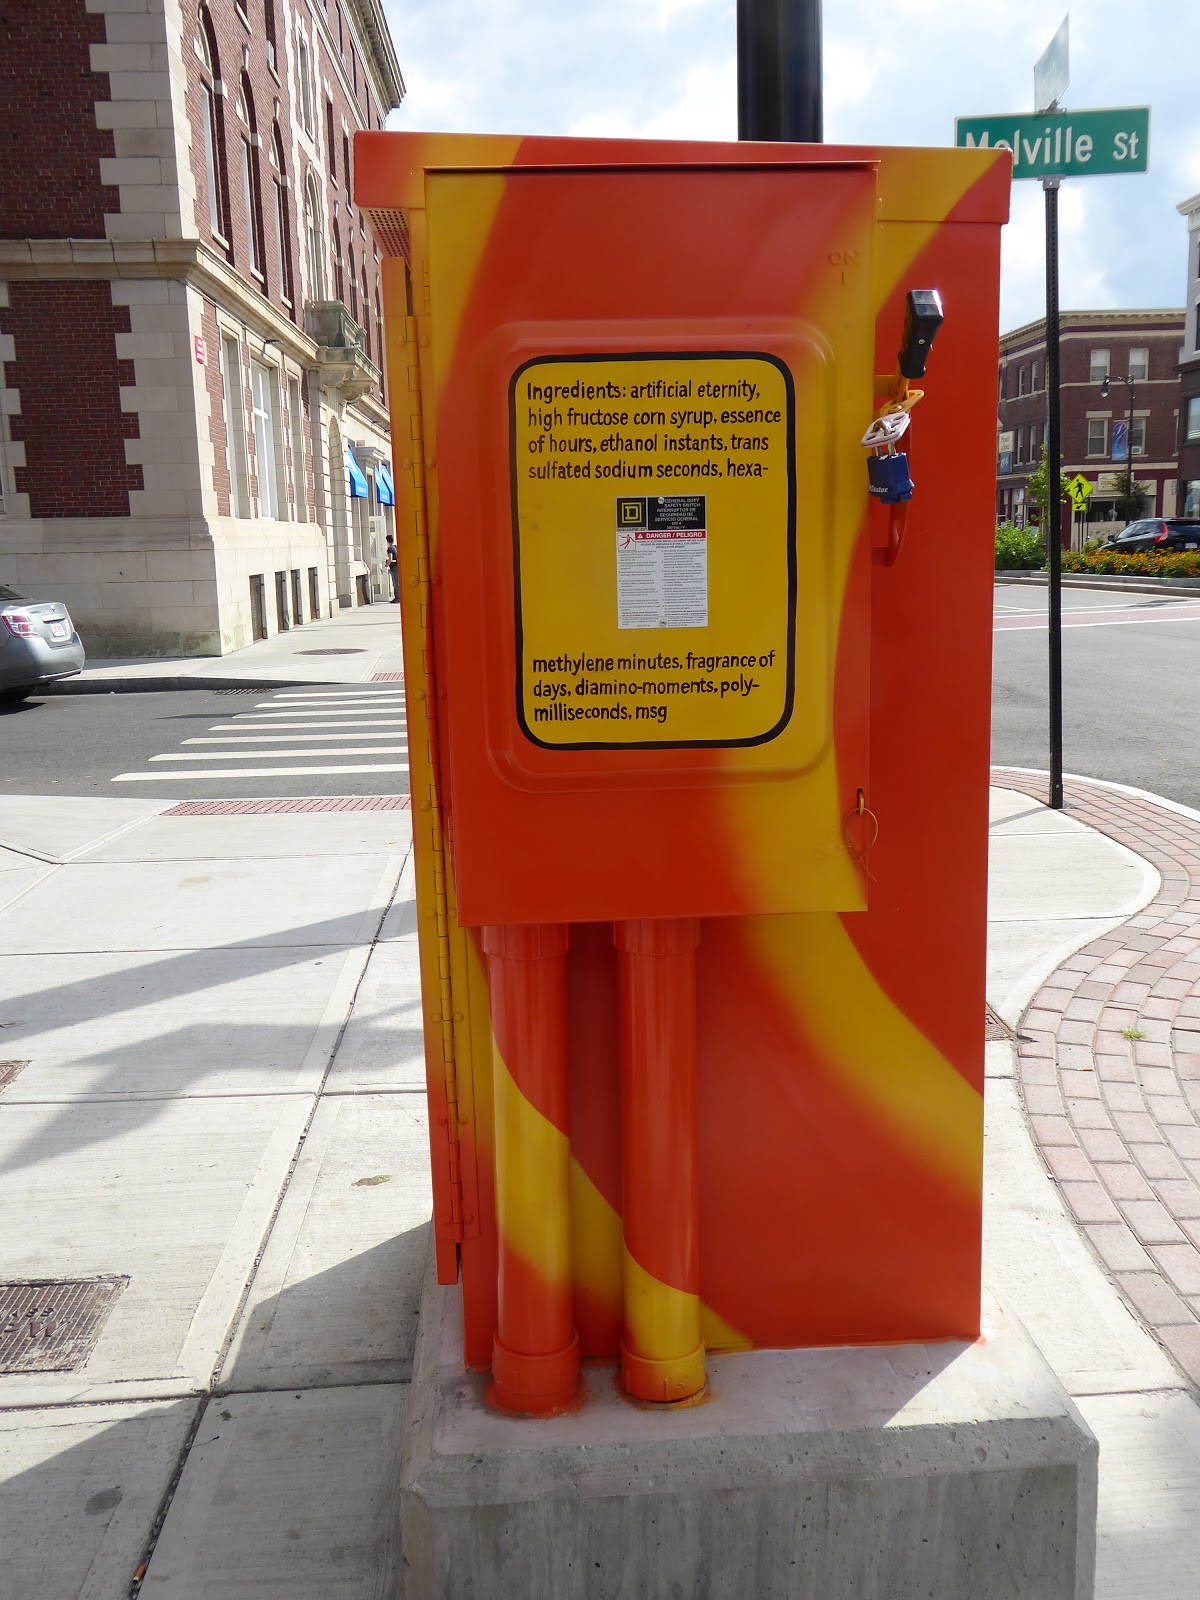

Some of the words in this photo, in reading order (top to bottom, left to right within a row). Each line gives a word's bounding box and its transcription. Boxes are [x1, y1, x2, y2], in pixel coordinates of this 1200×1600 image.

[1112, 130, 1139, 160] St
[527, 380, 626, 404] Ingredients:
[630, 380, 692, 399] artificial
[697, 379, 760, 402] eternity,
[528, 406, 563, 432] high
[566, 407, 629, 426] fructose
[633, 411, 665, 425] corn
[669, 410, 717, 429] syrup,
[720, 409, 781, 424] essence
[528, 434, 546, 454] of
[549, 433, 597, 454] hours,
[600, 432, 657, 452] ethanol
[664, 433, 728, 452] instants,
[730, 433, 769, 451] trans
[528, 460, 591, 480] sulfated
[594, 459, 653, 479] sodium
[656, 458, 723, 478] seconds,
[727, 457, 769, 477] hexa-
[533, 652, 614, 676] methylene
[617, 653, 683, 671] minutes,
[685, 652, 757, 673] fragrance
[758, 649, 776, 668] of
[533, 679, 572, 701] days,
[575, 678, 718, 697] diamino-moments,
[720, 673, 760, 699] poly-
[534, 702, 632, 722] milliseconds,
[635, 705, 668, 723] msg
